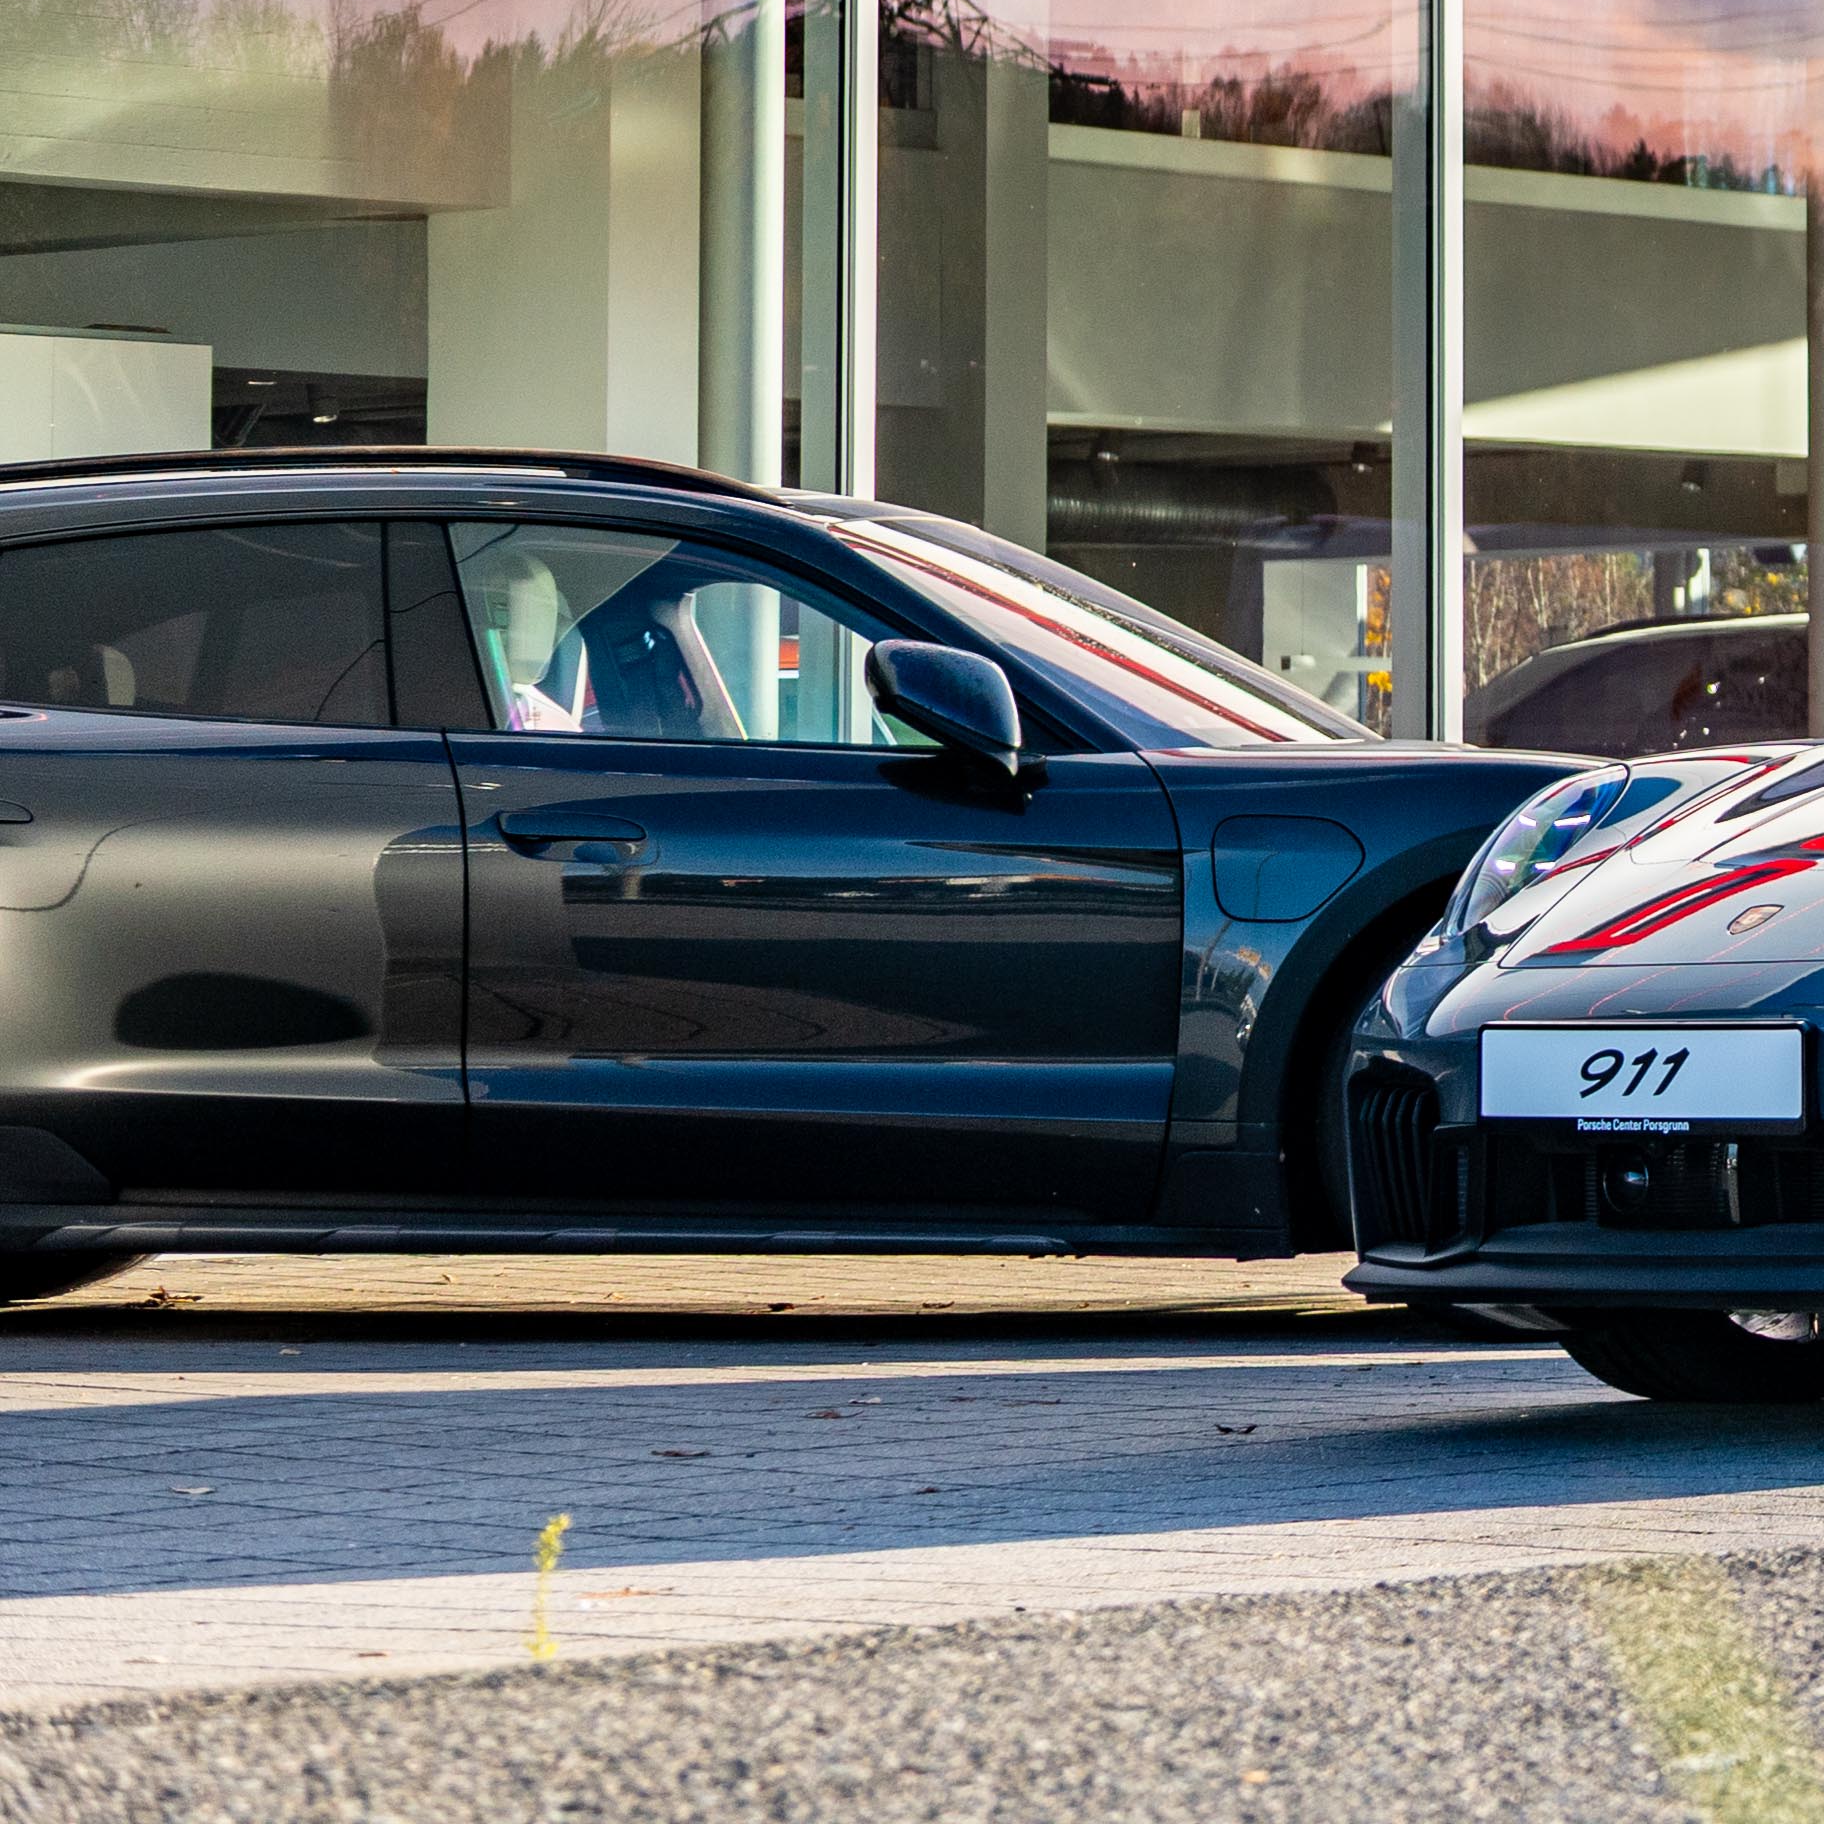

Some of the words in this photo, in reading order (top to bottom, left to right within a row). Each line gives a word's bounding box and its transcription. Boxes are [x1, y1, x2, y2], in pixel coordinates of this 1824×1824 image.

[1579, 1047, 1690, 1099] 911
[1577, 1118, 1612, 1131] Porsche
[1612, 1118, 1642, 1131] Center
[1643, 1118, 1690, 1134] Porsgrunn
